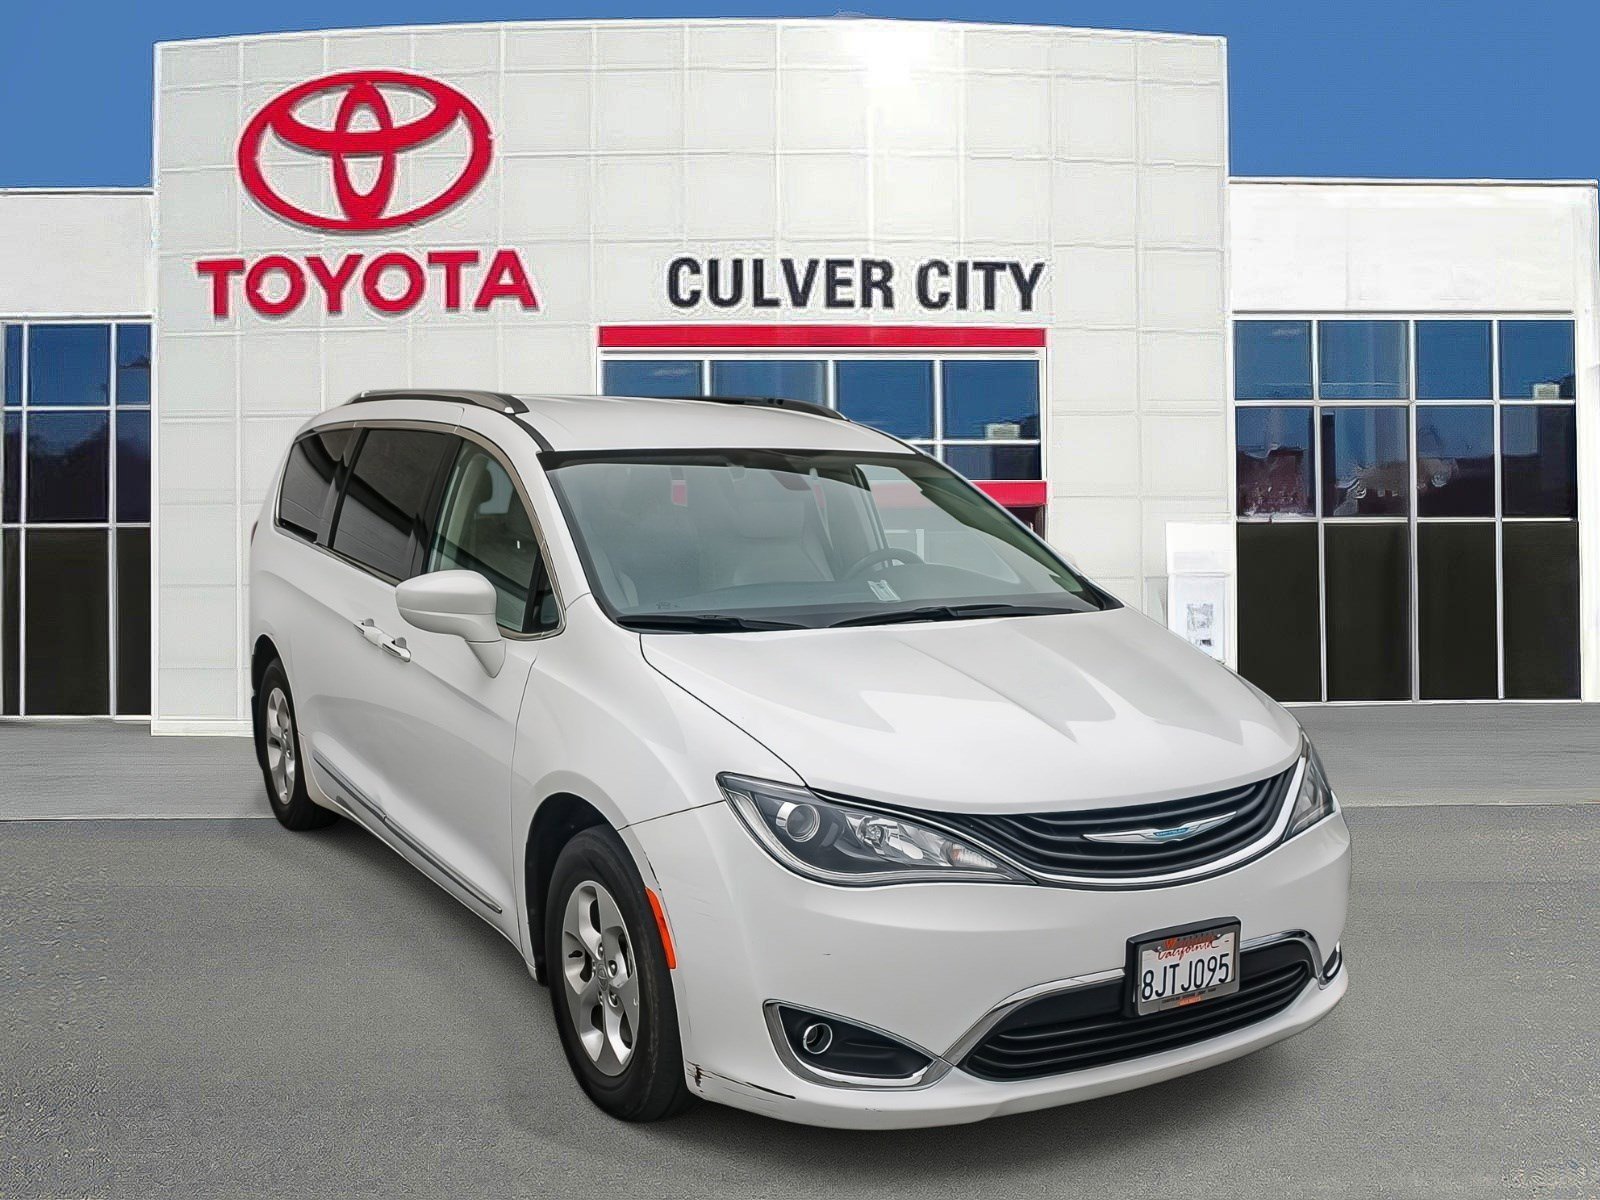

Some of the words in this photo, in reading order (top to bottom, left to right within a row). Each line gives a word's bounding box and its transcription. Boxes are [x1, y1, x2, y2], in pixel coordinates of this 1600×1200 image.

[196, 249, 538, 319] TOYOTA
[667, 257, 895, 309] CULVER
[915, 259, 1046, 311] CITY
[1142, 953, 1230, 1000] 8JTJ095
